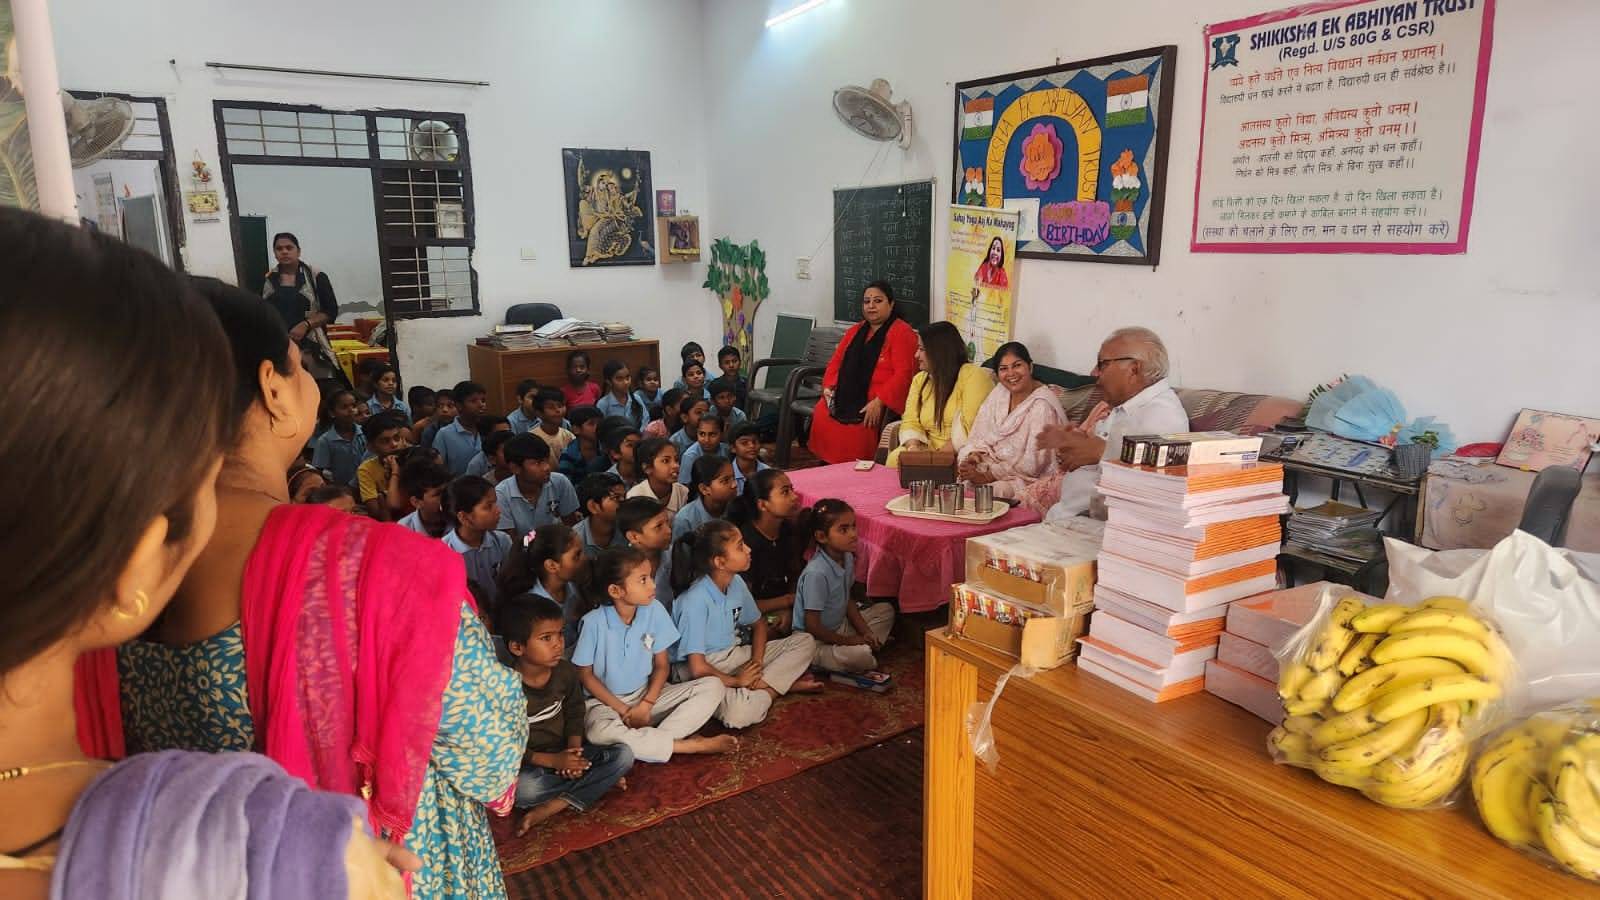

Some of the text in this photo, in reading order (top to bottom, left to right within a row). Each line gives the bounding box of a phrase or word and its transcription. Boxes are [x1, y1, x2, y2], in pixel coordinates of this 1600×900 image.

[1250, 20, 1317, 50] SHIKKSHA
[1322, 16, 1340, 35] EK
[1345, 2, 1418, 32] ABHIYAN
[1278, 20, 1435, 62] (Regd. U/S 80G & CSR)
[1373, 72, 1386, 82] धन
[1368, 141, 1379, 153] को
[1383, 143, 1396, 153] धन
[1357, 189, 1372, 201] दिन
[1376, 189, 1398, 201] खिला
[1401, 190, 1427, 201] सकता
[1046, 221, 1107, 242] BIRTHDAY
[1322, 225, 1336, 236] मन
[1352, 225, 1366, 236] धन
[1372, 220, 1381, 236] से
[1387, 220, 1423, 237] सहयोग
